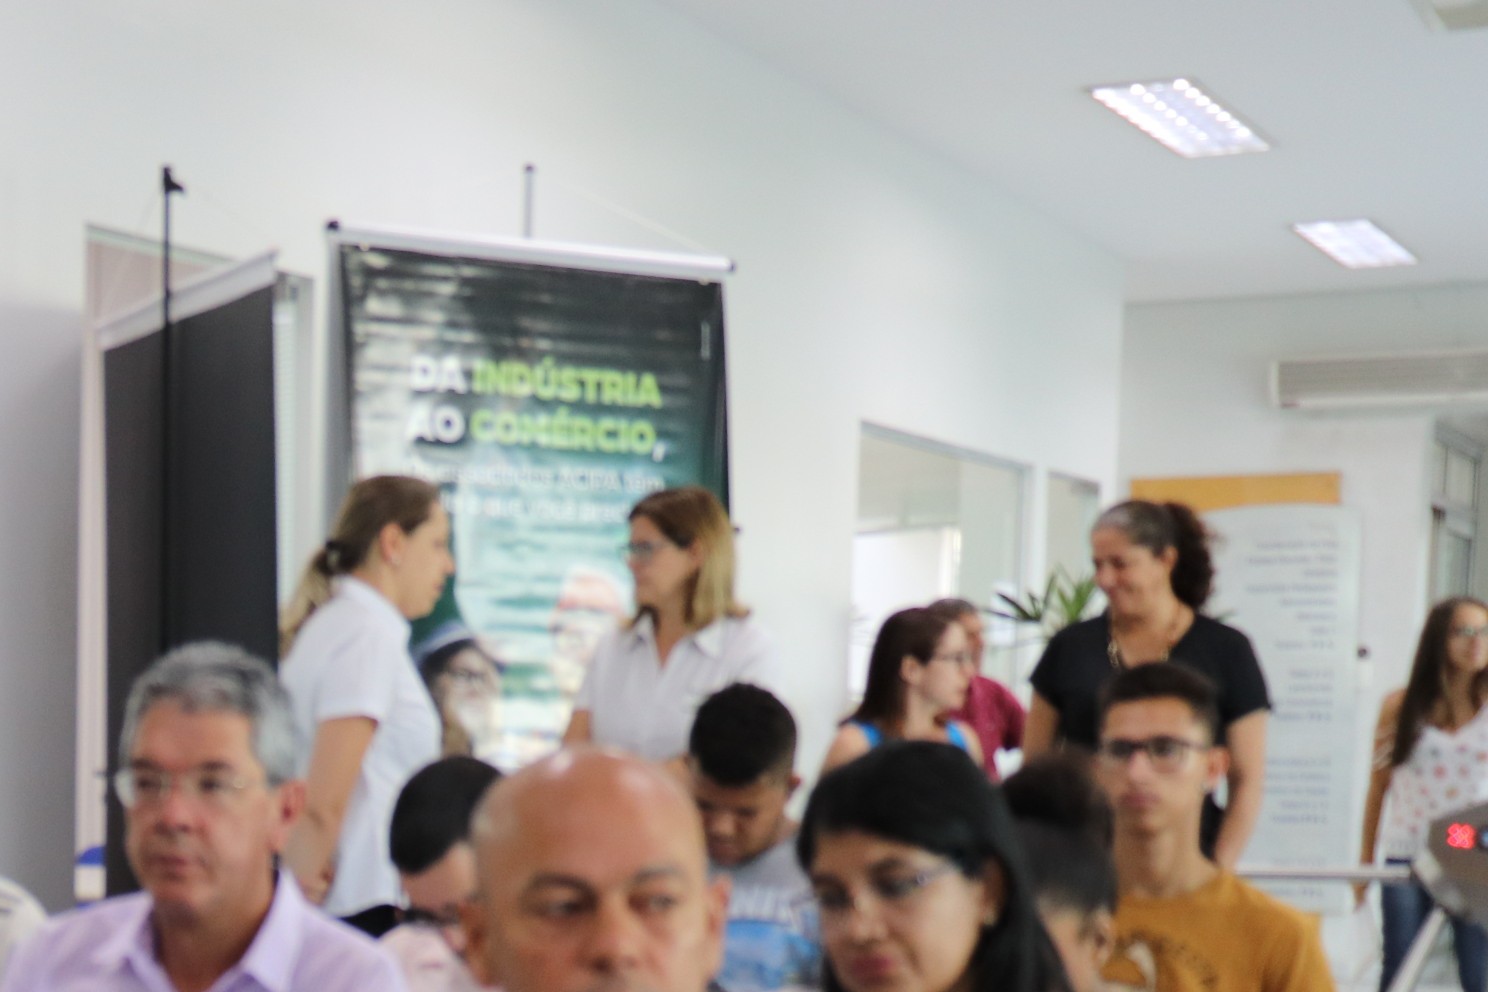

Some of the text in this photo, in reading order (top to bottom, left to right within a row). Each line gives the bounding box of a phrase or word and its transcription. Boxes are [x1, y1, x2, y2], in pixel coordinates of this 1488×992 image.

[411, 354, 663, 409] DA INDÚSTRIA
[407, 402, 666, 462] AO COMÉRCIO,
